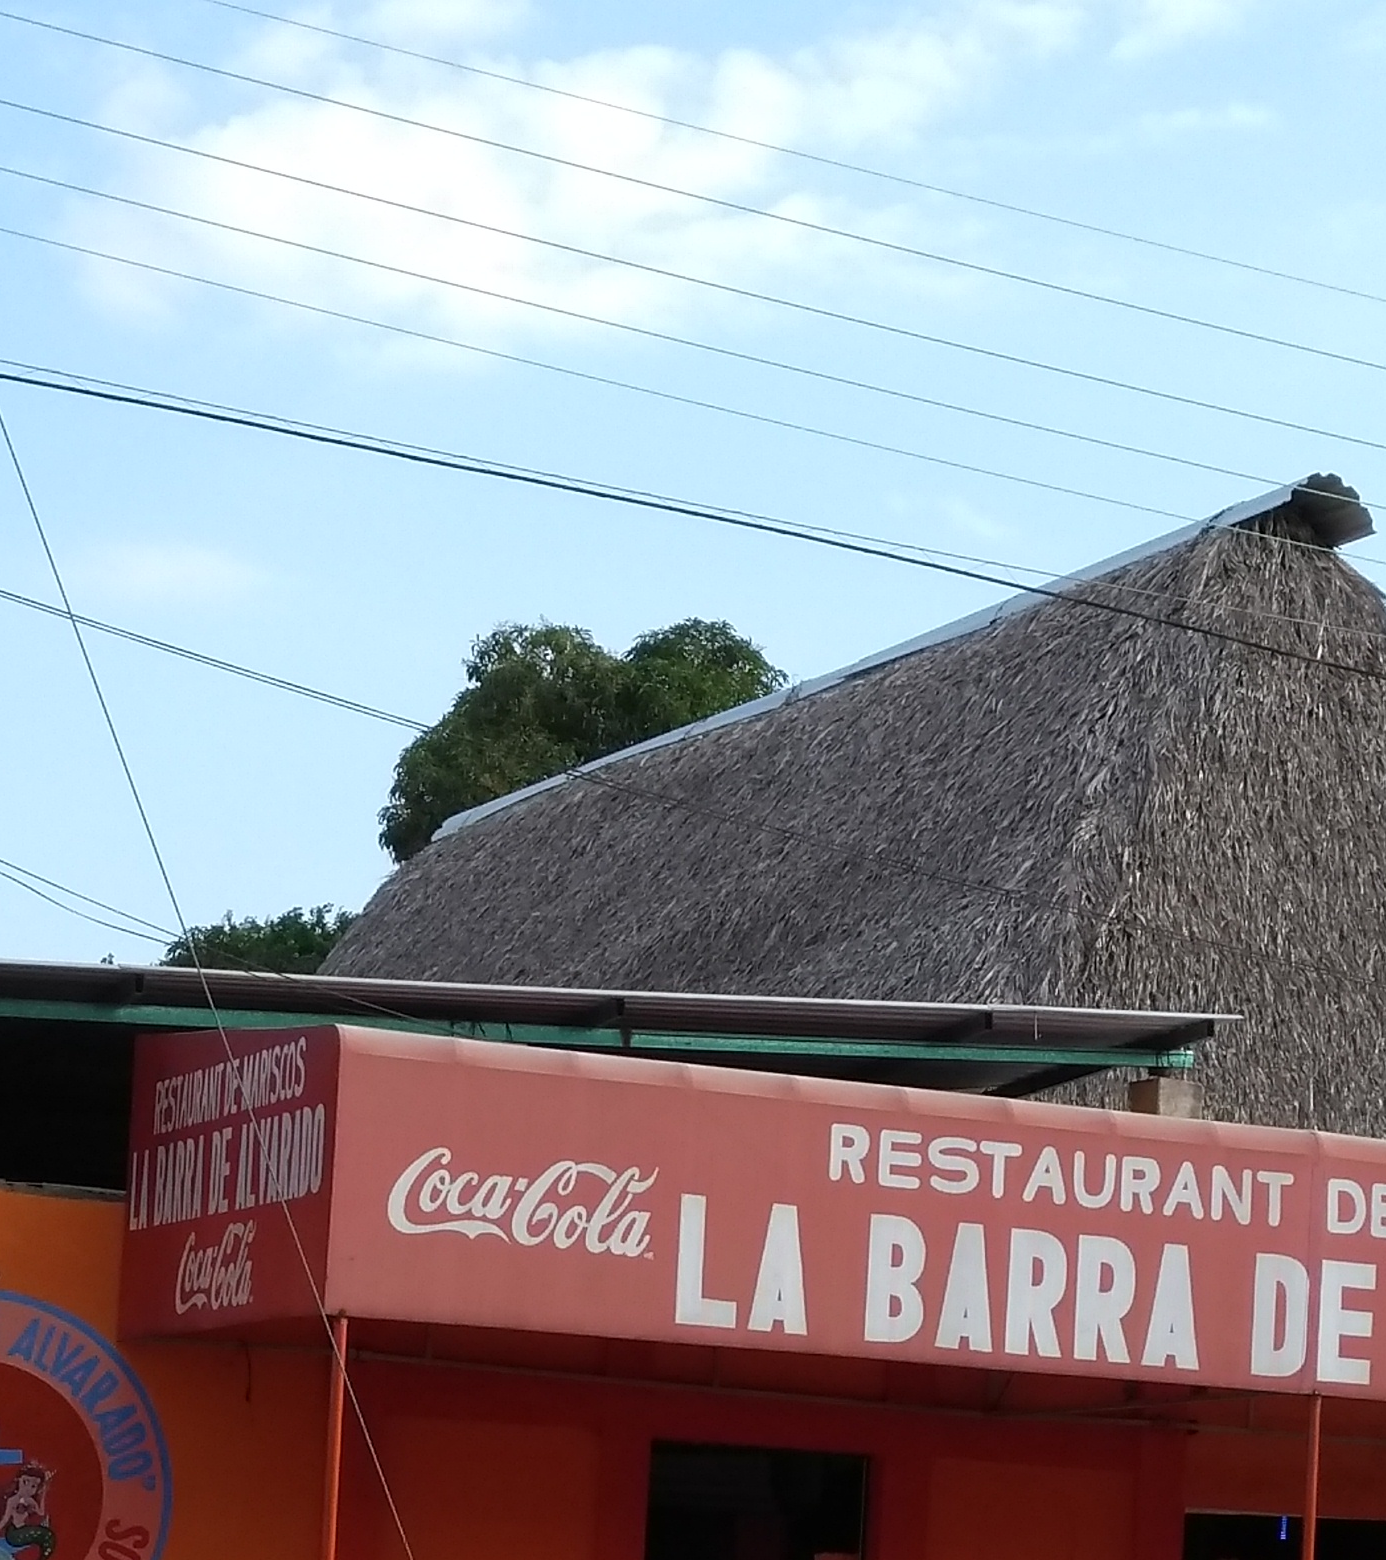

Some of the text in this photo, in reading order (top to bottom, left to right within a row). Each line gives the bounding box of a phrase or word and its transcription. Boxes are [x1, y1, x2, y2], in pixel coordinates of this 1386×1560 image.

[153, 1036, 307, 1135] RESTAURANT DE MARISCOS
[129, 1103, 325, 1231] LA BARRA DE ALVARADO
[386, 1146, 659, 1259] Coca-Cola
[828, 1122, 1295, 1228] RESTAURANT
[175, 1219, 256, 1315] Coca-Cola
[674, 1192, 808, 1337] LA
[863, 1213, 1200, 1372] BARRA
[1250, 1252, 1378, 1386] DE
